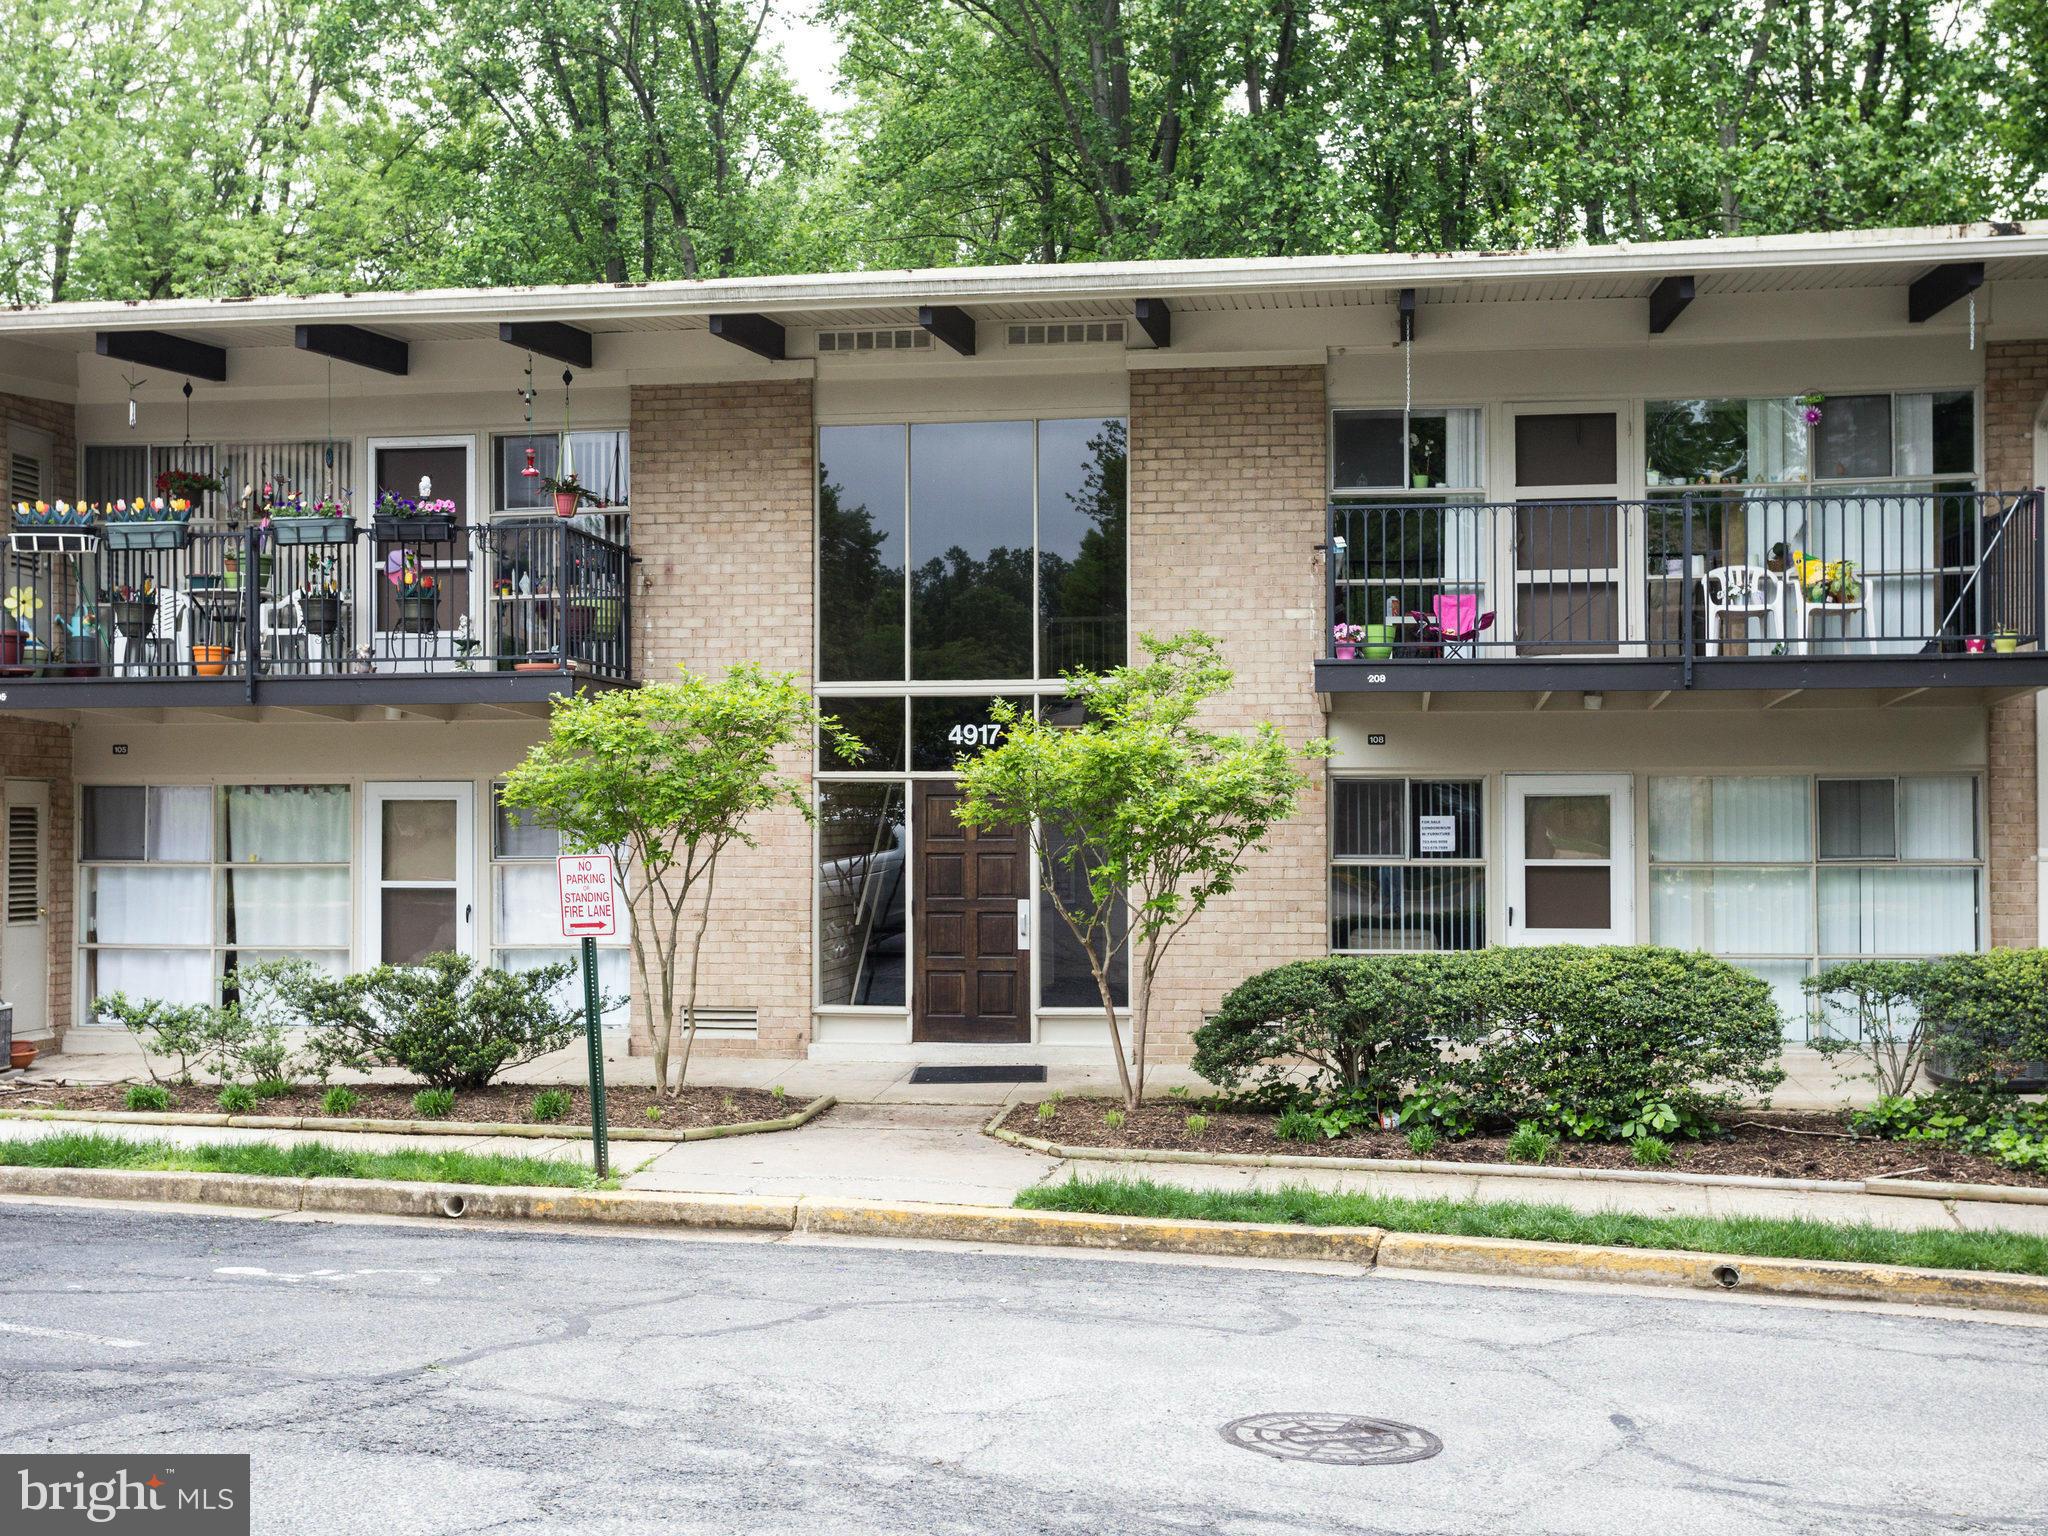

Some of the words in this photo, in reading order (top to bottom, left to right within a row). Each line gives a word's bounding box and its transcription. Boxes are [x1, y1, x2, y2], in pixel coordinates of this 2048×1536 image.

[1367, 674, 1386, 683] 208
[948, 724, 1001, 745] 4917
[1369, 736, 1384, 744] 108
[578, 861, 592, 871] NO
[566, 873, 606, 884] PARKING
[564, 892, 610, 903] STANDING
[564, 905, 584, 918] FIRE
[587, 904, 612, 917] LANE
